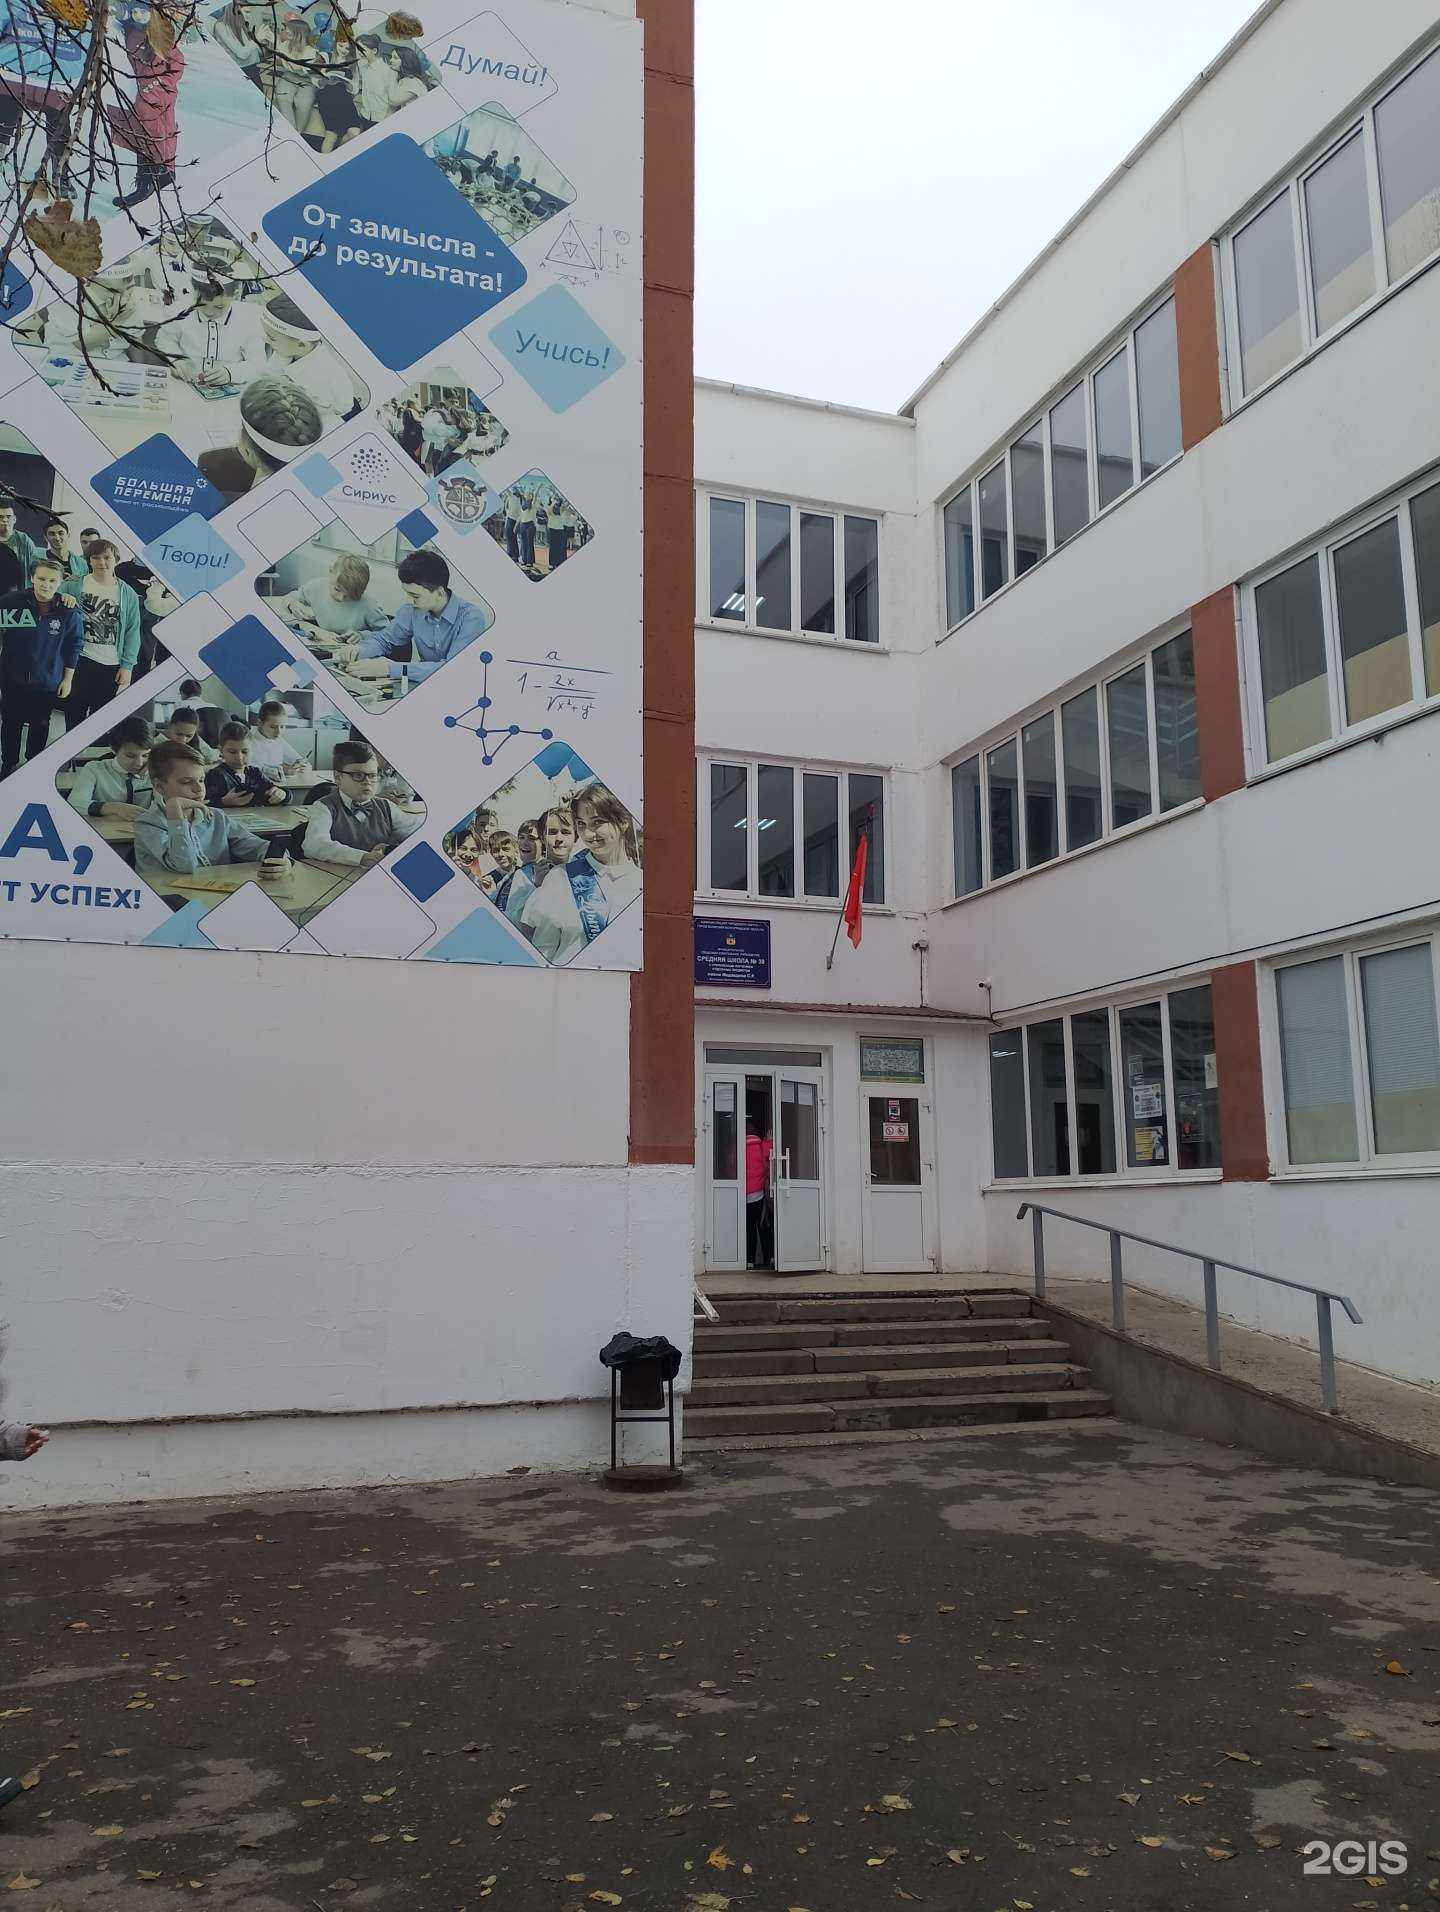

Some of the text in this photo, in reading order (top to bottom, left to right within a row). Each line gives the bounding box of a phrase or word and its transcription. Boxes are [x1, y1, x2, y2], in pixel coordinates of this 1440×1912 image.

[440, 44, 548, 87] Думай!
[302, 203, 342, 230] От
[348, 217, 477, 259] замысла
[288, 235, 503, 293] до результата!
[515, 329, 610, 369] Учись!
[113, 485, 192, 505] ПЕРЕМЕНА
[116, 476, 195, 496] БОЛЬШАЯ
[342, 485, 397, 504] Сириус
[159, 543, 230, 569] Твори!
[0, 608, 37, 627] КА
[0, 880, 142, 910] Т УСПЕХ!
[696, 955, 726, 963] СРЕДНЯЯ
[727, 957, 749, 965] ШКОЛА
